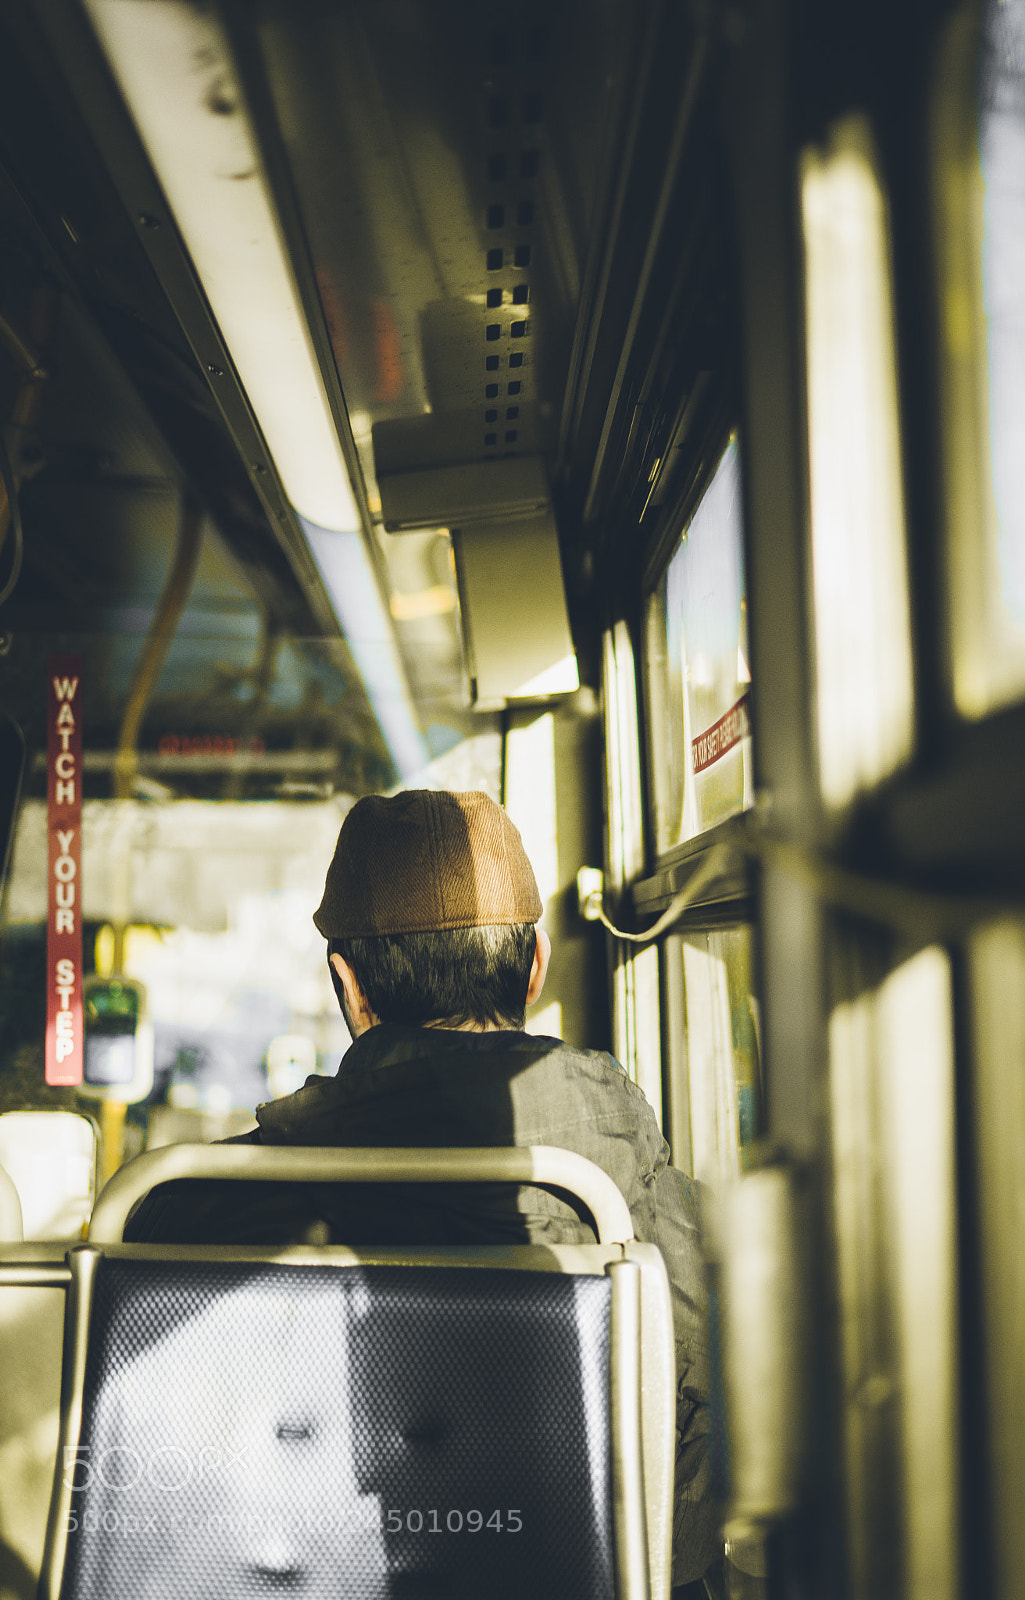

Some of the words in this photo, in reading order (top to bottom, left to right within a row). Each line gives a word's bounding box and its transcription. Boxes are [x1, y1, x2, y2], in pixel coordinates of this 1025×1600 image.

[52, 676, 79, 805] WATCH
[54, 829, 77, 934] YOUR
[54, 958, 76, 1064] STEP
